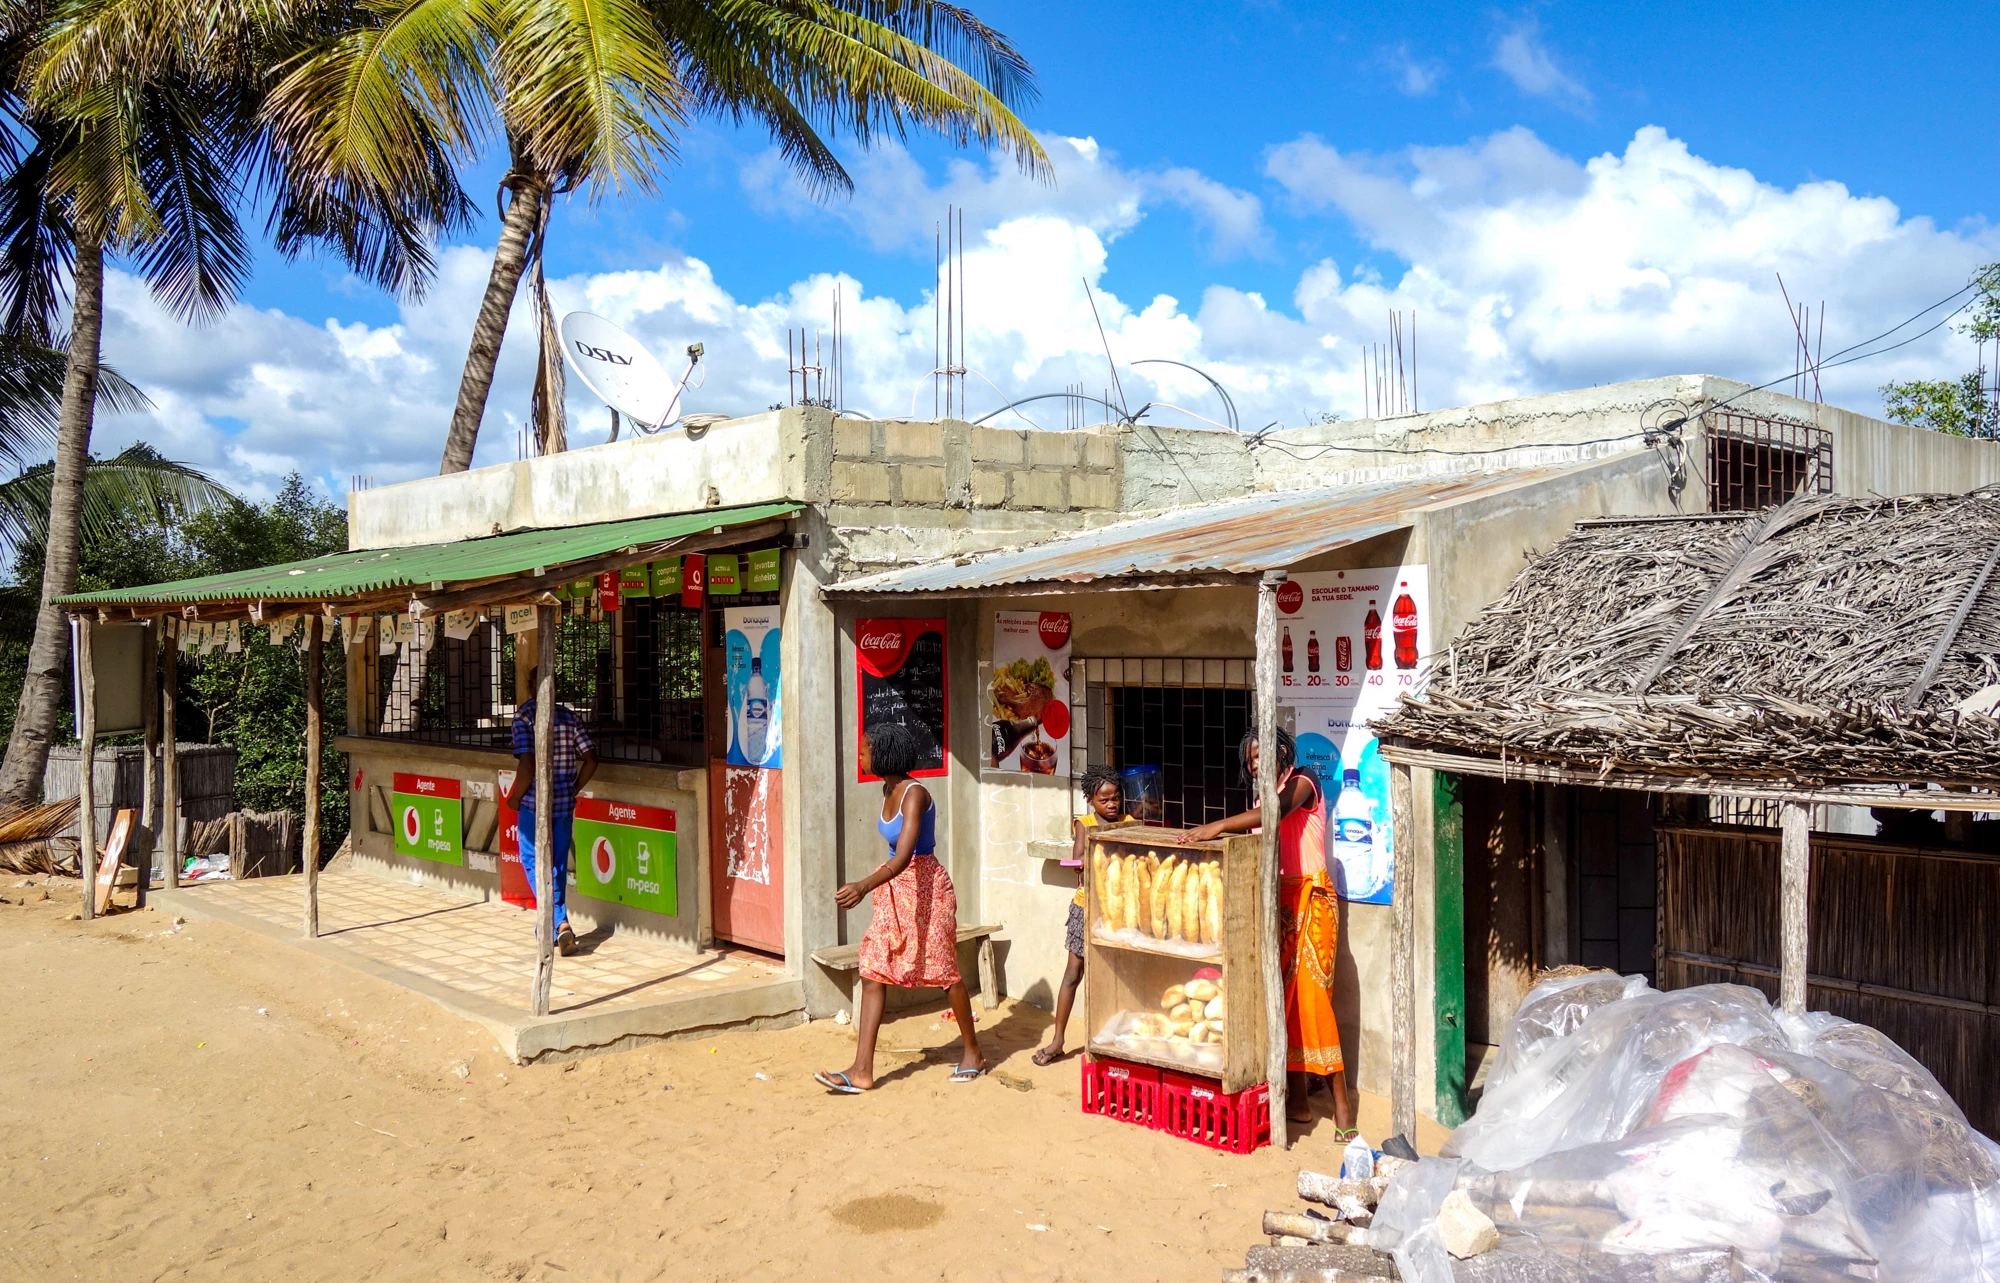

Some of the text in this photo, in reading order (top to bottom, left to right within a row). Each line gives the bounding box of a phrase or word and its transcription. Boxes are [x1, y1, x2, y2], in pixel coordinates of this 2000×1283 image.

[575, 340, 633, 365] DStv
[657, 566, 677, 576] comprar
[754, 561, 776, 570] levantar
[659, 577, 676, 586] crédito
[754, 572, 776, 582] dinheiro
[1312, 587, 1340, 595] ESCOLHE
[1348, 585, 1380, 593] TAMANHO
[1277, 592, 1301, 603] Coca-Cola
[511, 605, 532, 620] mcel
[1040, 618, 1070, 633] Coca-Cola
[860, 632, 902, 650] Coca-Cola
[1281, 675, 1293, 686] 15
[1307, 675, 1321, 686] 20
[1335, 675, 1350, 686] 30
[1368, 675, 1383, 686] 40
[1397, 675, 1412, 686] 70
[1306, 752, 1330, 761] Refresca
[1312, 762, 1326, 770] alma
[416, 779, 435, 792] Agente
[609, 803, 636, 820] Agente
[428, 838, 451, 853] m-pesa
[627, 877, 659, 895] m-pesa
